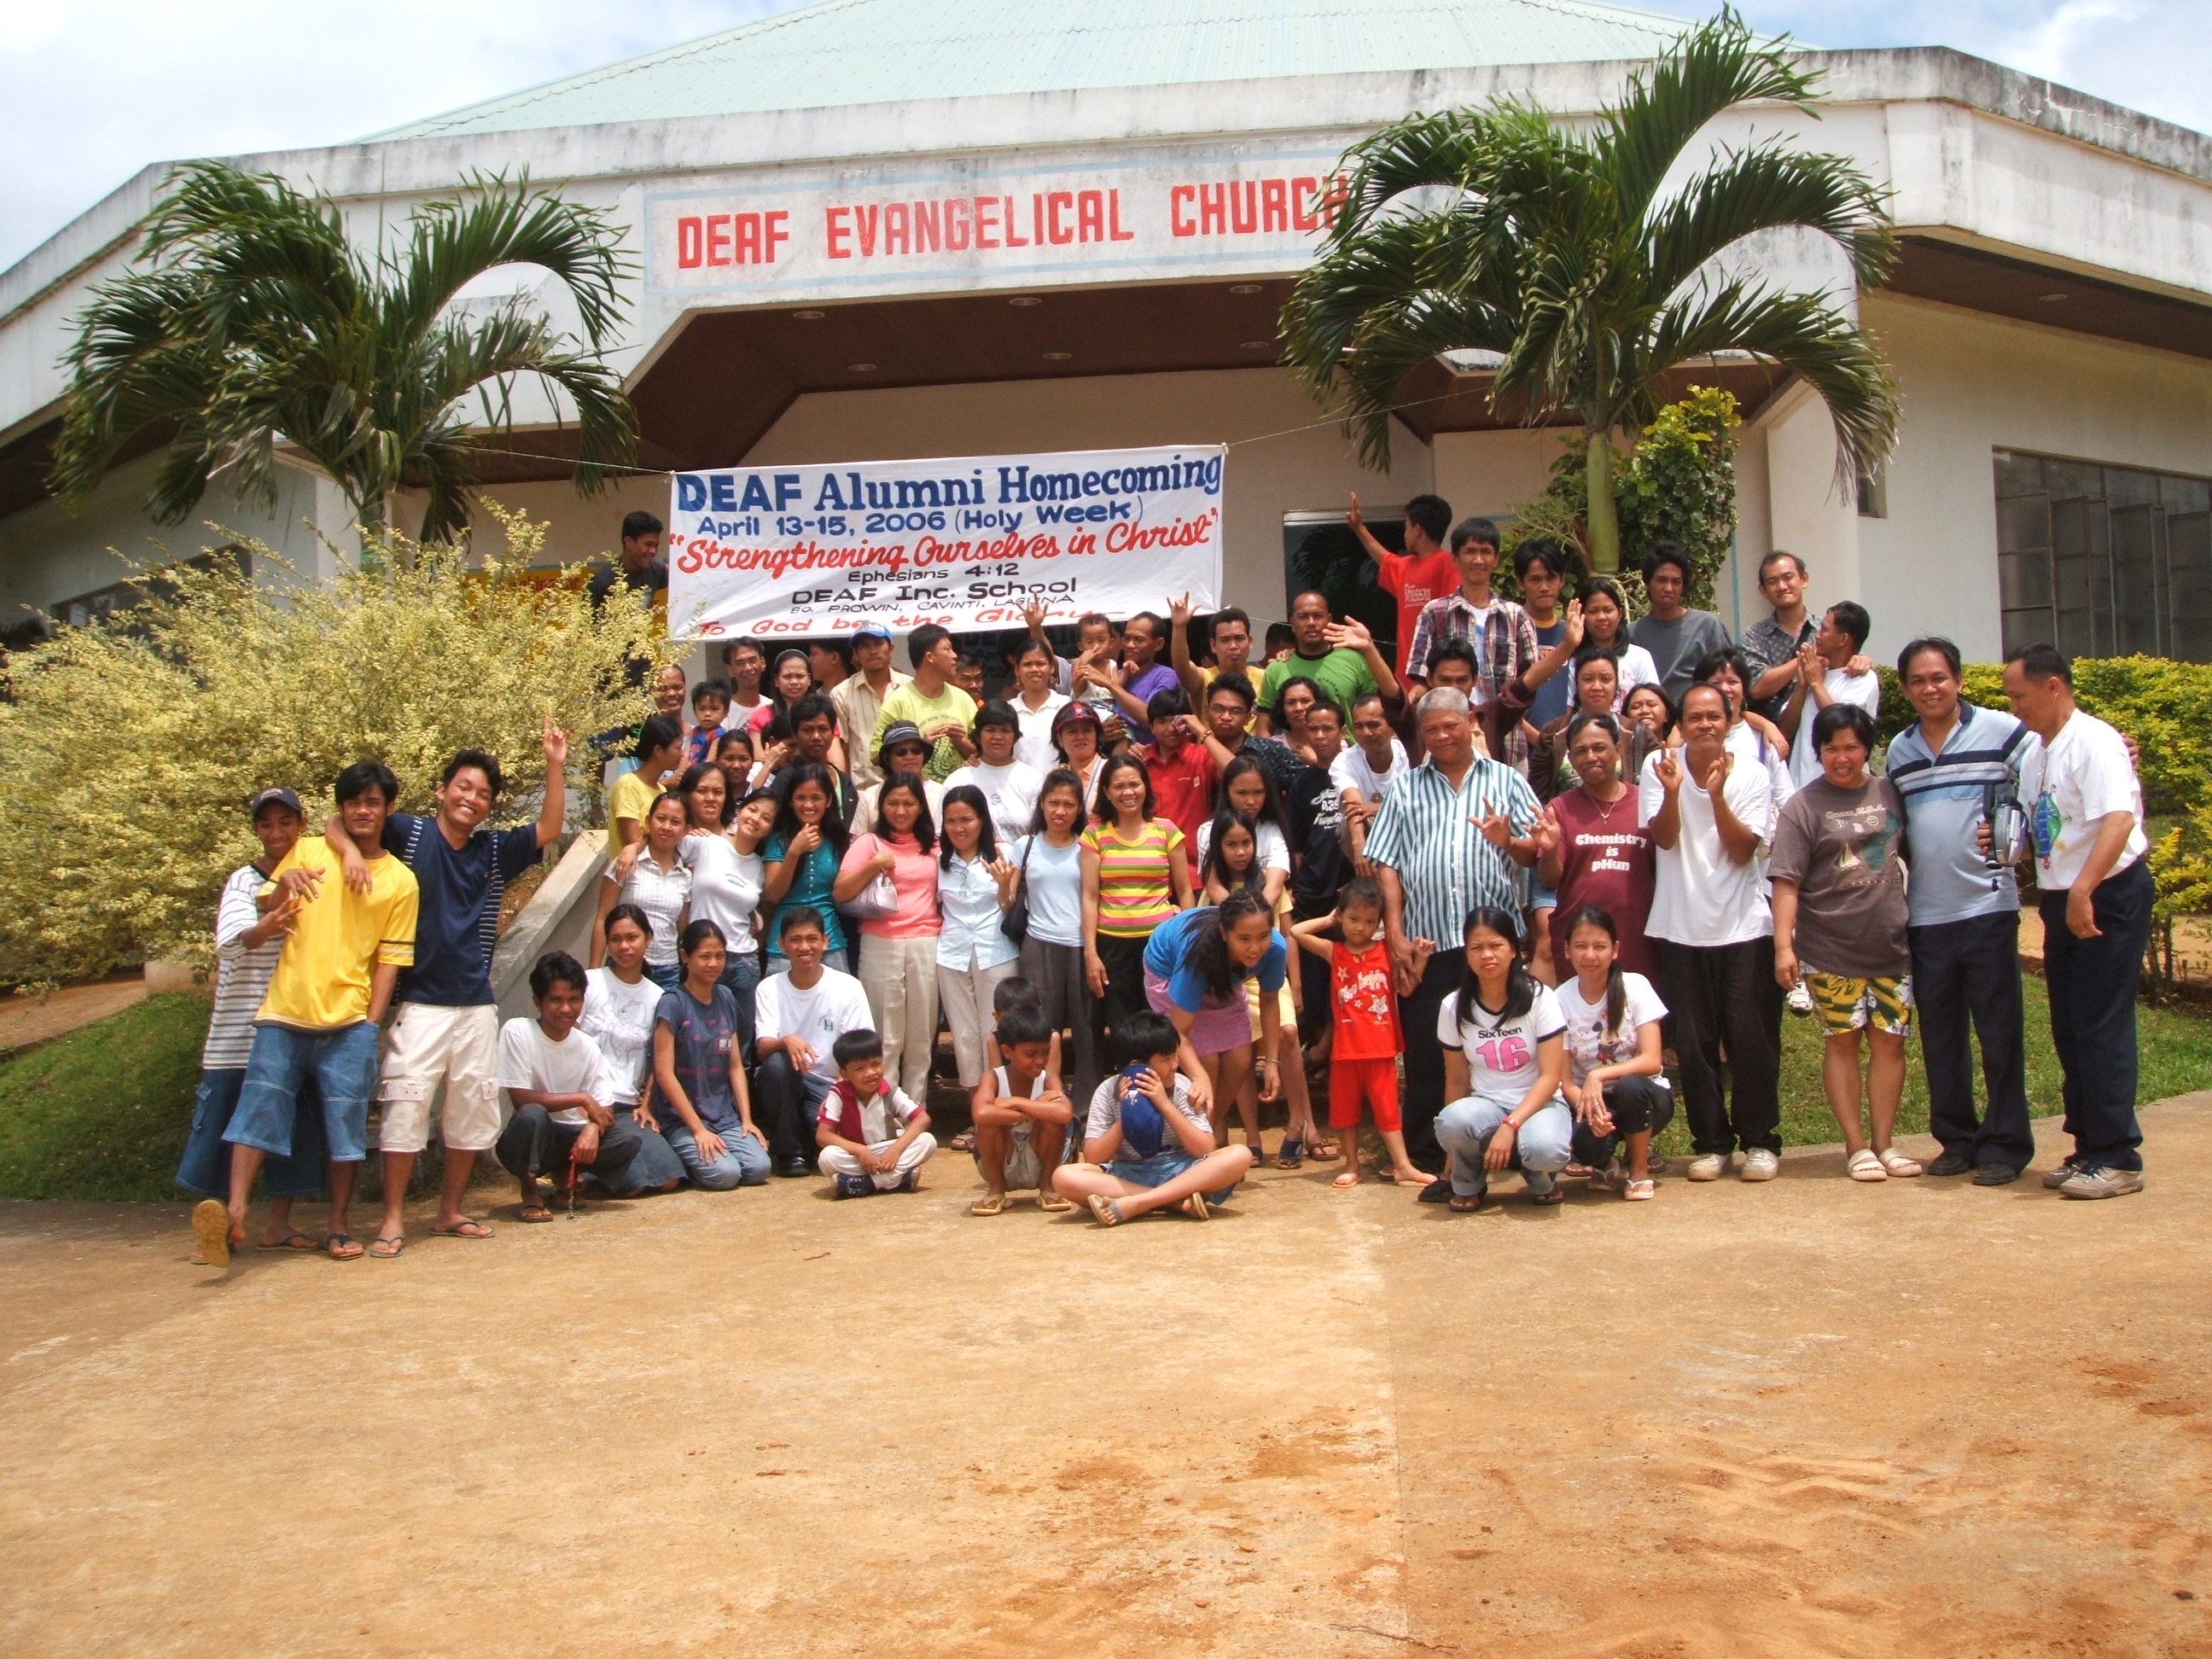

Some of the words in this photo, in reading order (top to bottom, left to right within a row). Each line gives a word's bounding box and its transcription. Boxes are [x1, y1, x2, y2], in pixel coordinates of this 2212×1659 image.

[678, 210, 789, 269] DEAF
[826, 189, 1134, 259] EVANGELICAL
[1171, 175, 1350, 236] CHURCH
[676, 473, 802, 512] DEAF
[813, 469, 986, 511] Alumni
[998, 454, 1222, 504] Homecoming
[697, 515, 760, 540] April
[777, 515, 855, 537] 13-15,
[865, 511, 946, 533] 2006
[956, 509, 1023, 534] (Holy
[1036, 495, 1144, 525] Week)
[914, 532, 1060, 568] Ourselves
[1068, 526, 1096, 555] in
[847, 568, 949, 585] Ephesians
[964, 562, 1020, 578] 4:12
[792, 587, 878, 605] DEAF
[895, 585, 957, 601] Inc.
[967, 577, 1077, 600] School
[699, 620, 726, 637] To
[752, 619, 813, 634] God
[893, 614, 953, 627] the
[1575, 833, 1647, 848] Chemistry
[1606, 846, 1620, 857] is
[1592, 859, 1631, 872] pHun
[1478, 1027, 1522, 1039] SixTeen
[1476, 1036, 1531, 1073] 16
